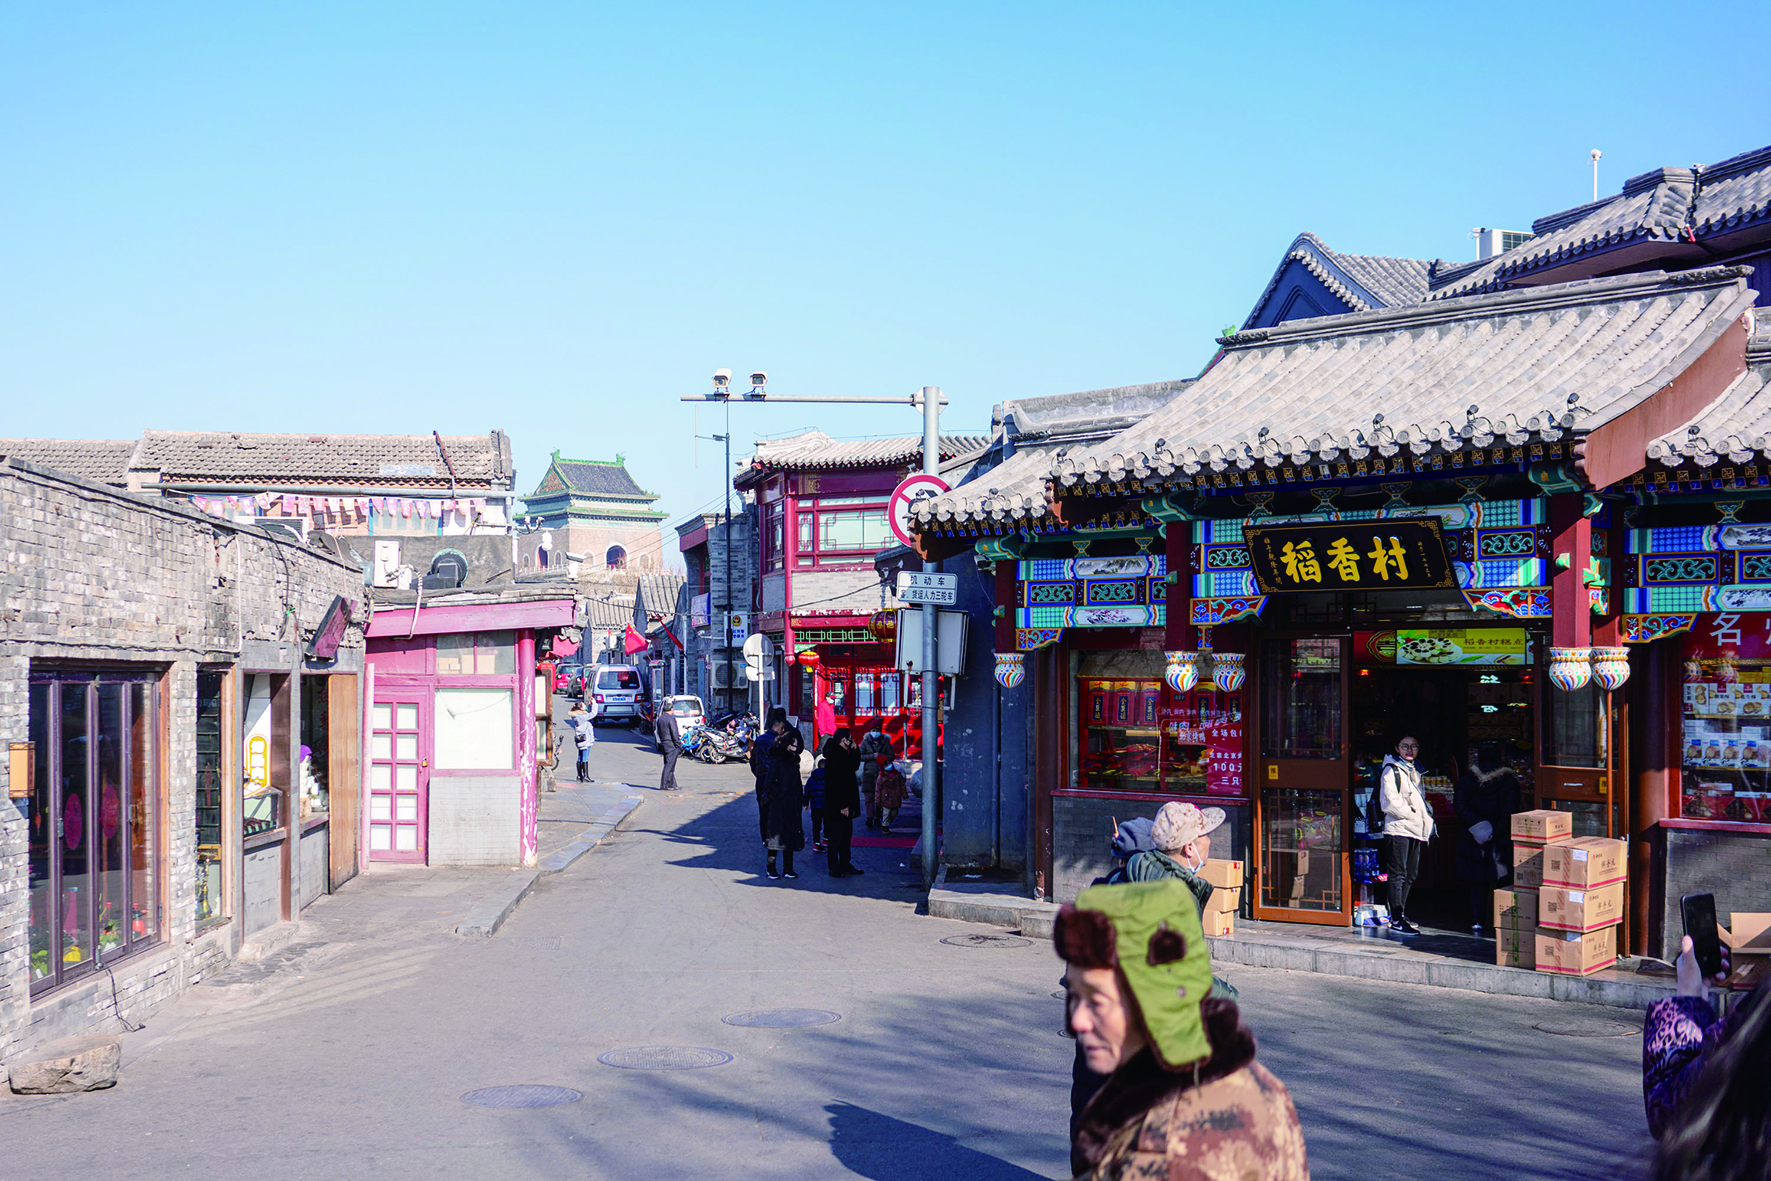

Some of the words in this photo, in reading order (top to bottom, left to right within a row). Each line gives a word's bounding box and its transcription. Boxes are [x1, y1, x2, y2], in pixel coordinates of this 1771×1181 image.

[1279, 536, 1409, 584] 稻香村
[1463, 638, 1524, 647] 稻香村糕点
